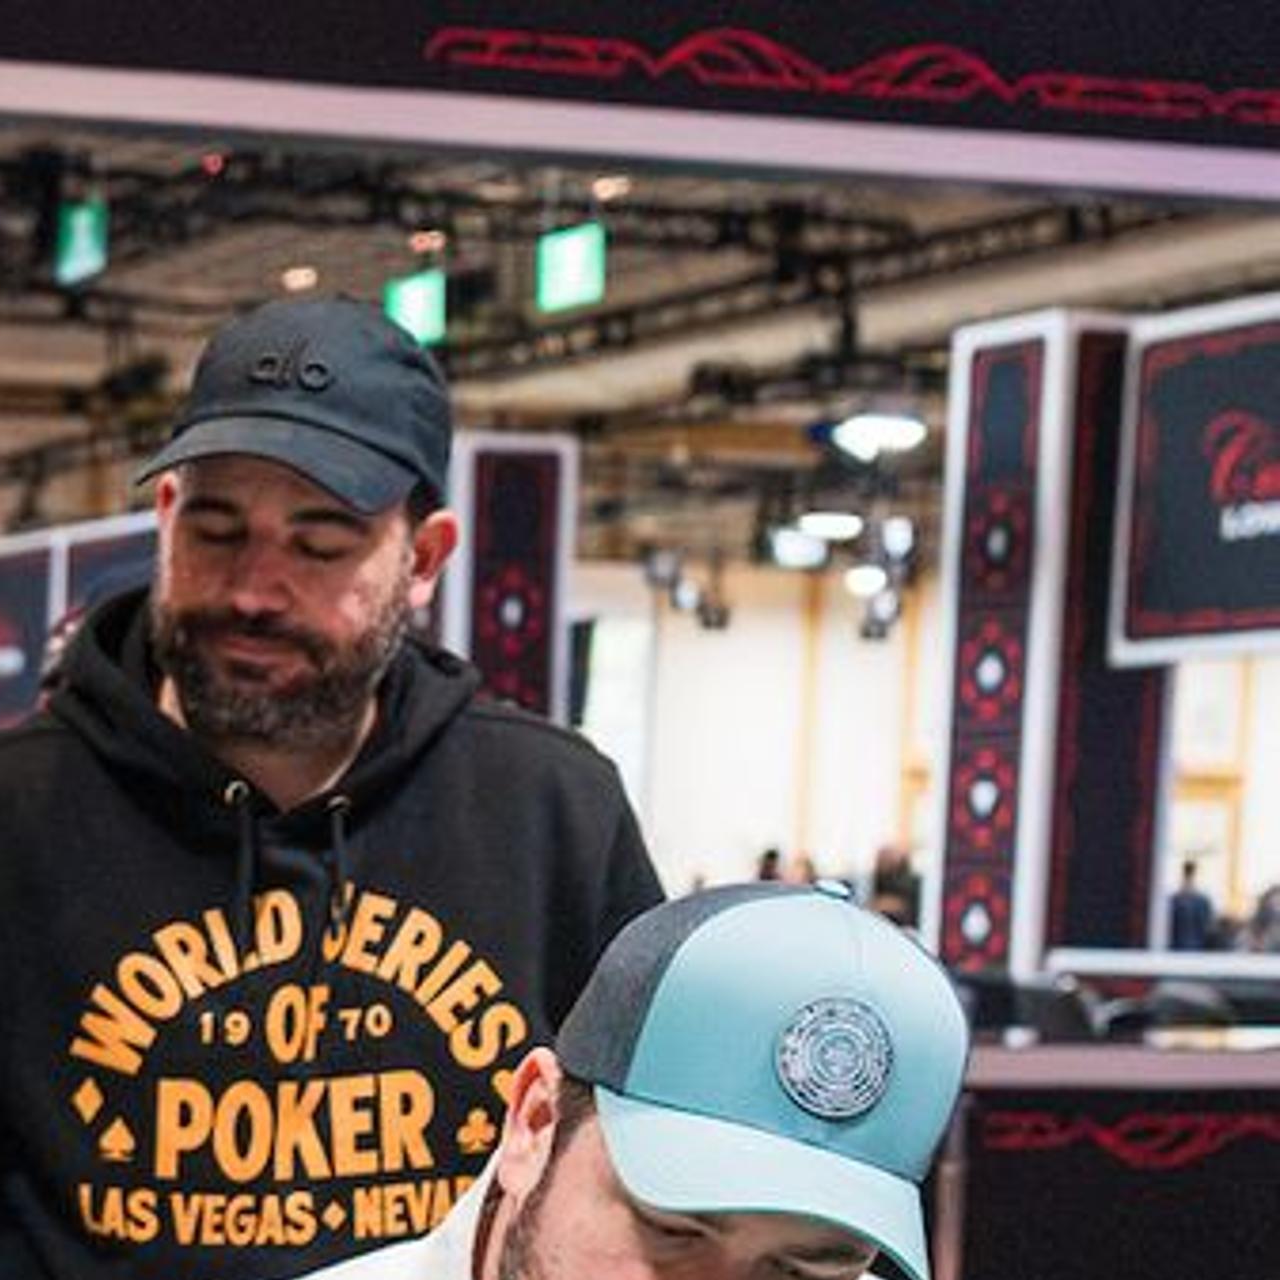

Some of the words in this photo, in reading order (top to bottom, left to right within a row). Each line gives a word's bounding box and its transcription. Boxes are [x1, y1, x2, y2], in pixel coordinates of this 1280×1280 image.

[72, 890, 302, 1074] WORLD
[200, 1011, 251, 1044] 19
[265, 984, 331, 1063] OF
[338, 1003, 393, 1042] 70
[155, 1069, 434, 1182] POKER
[78, 1183, 159, 1243] LAS
[170, 1189, 318, 1246] VEGAS
